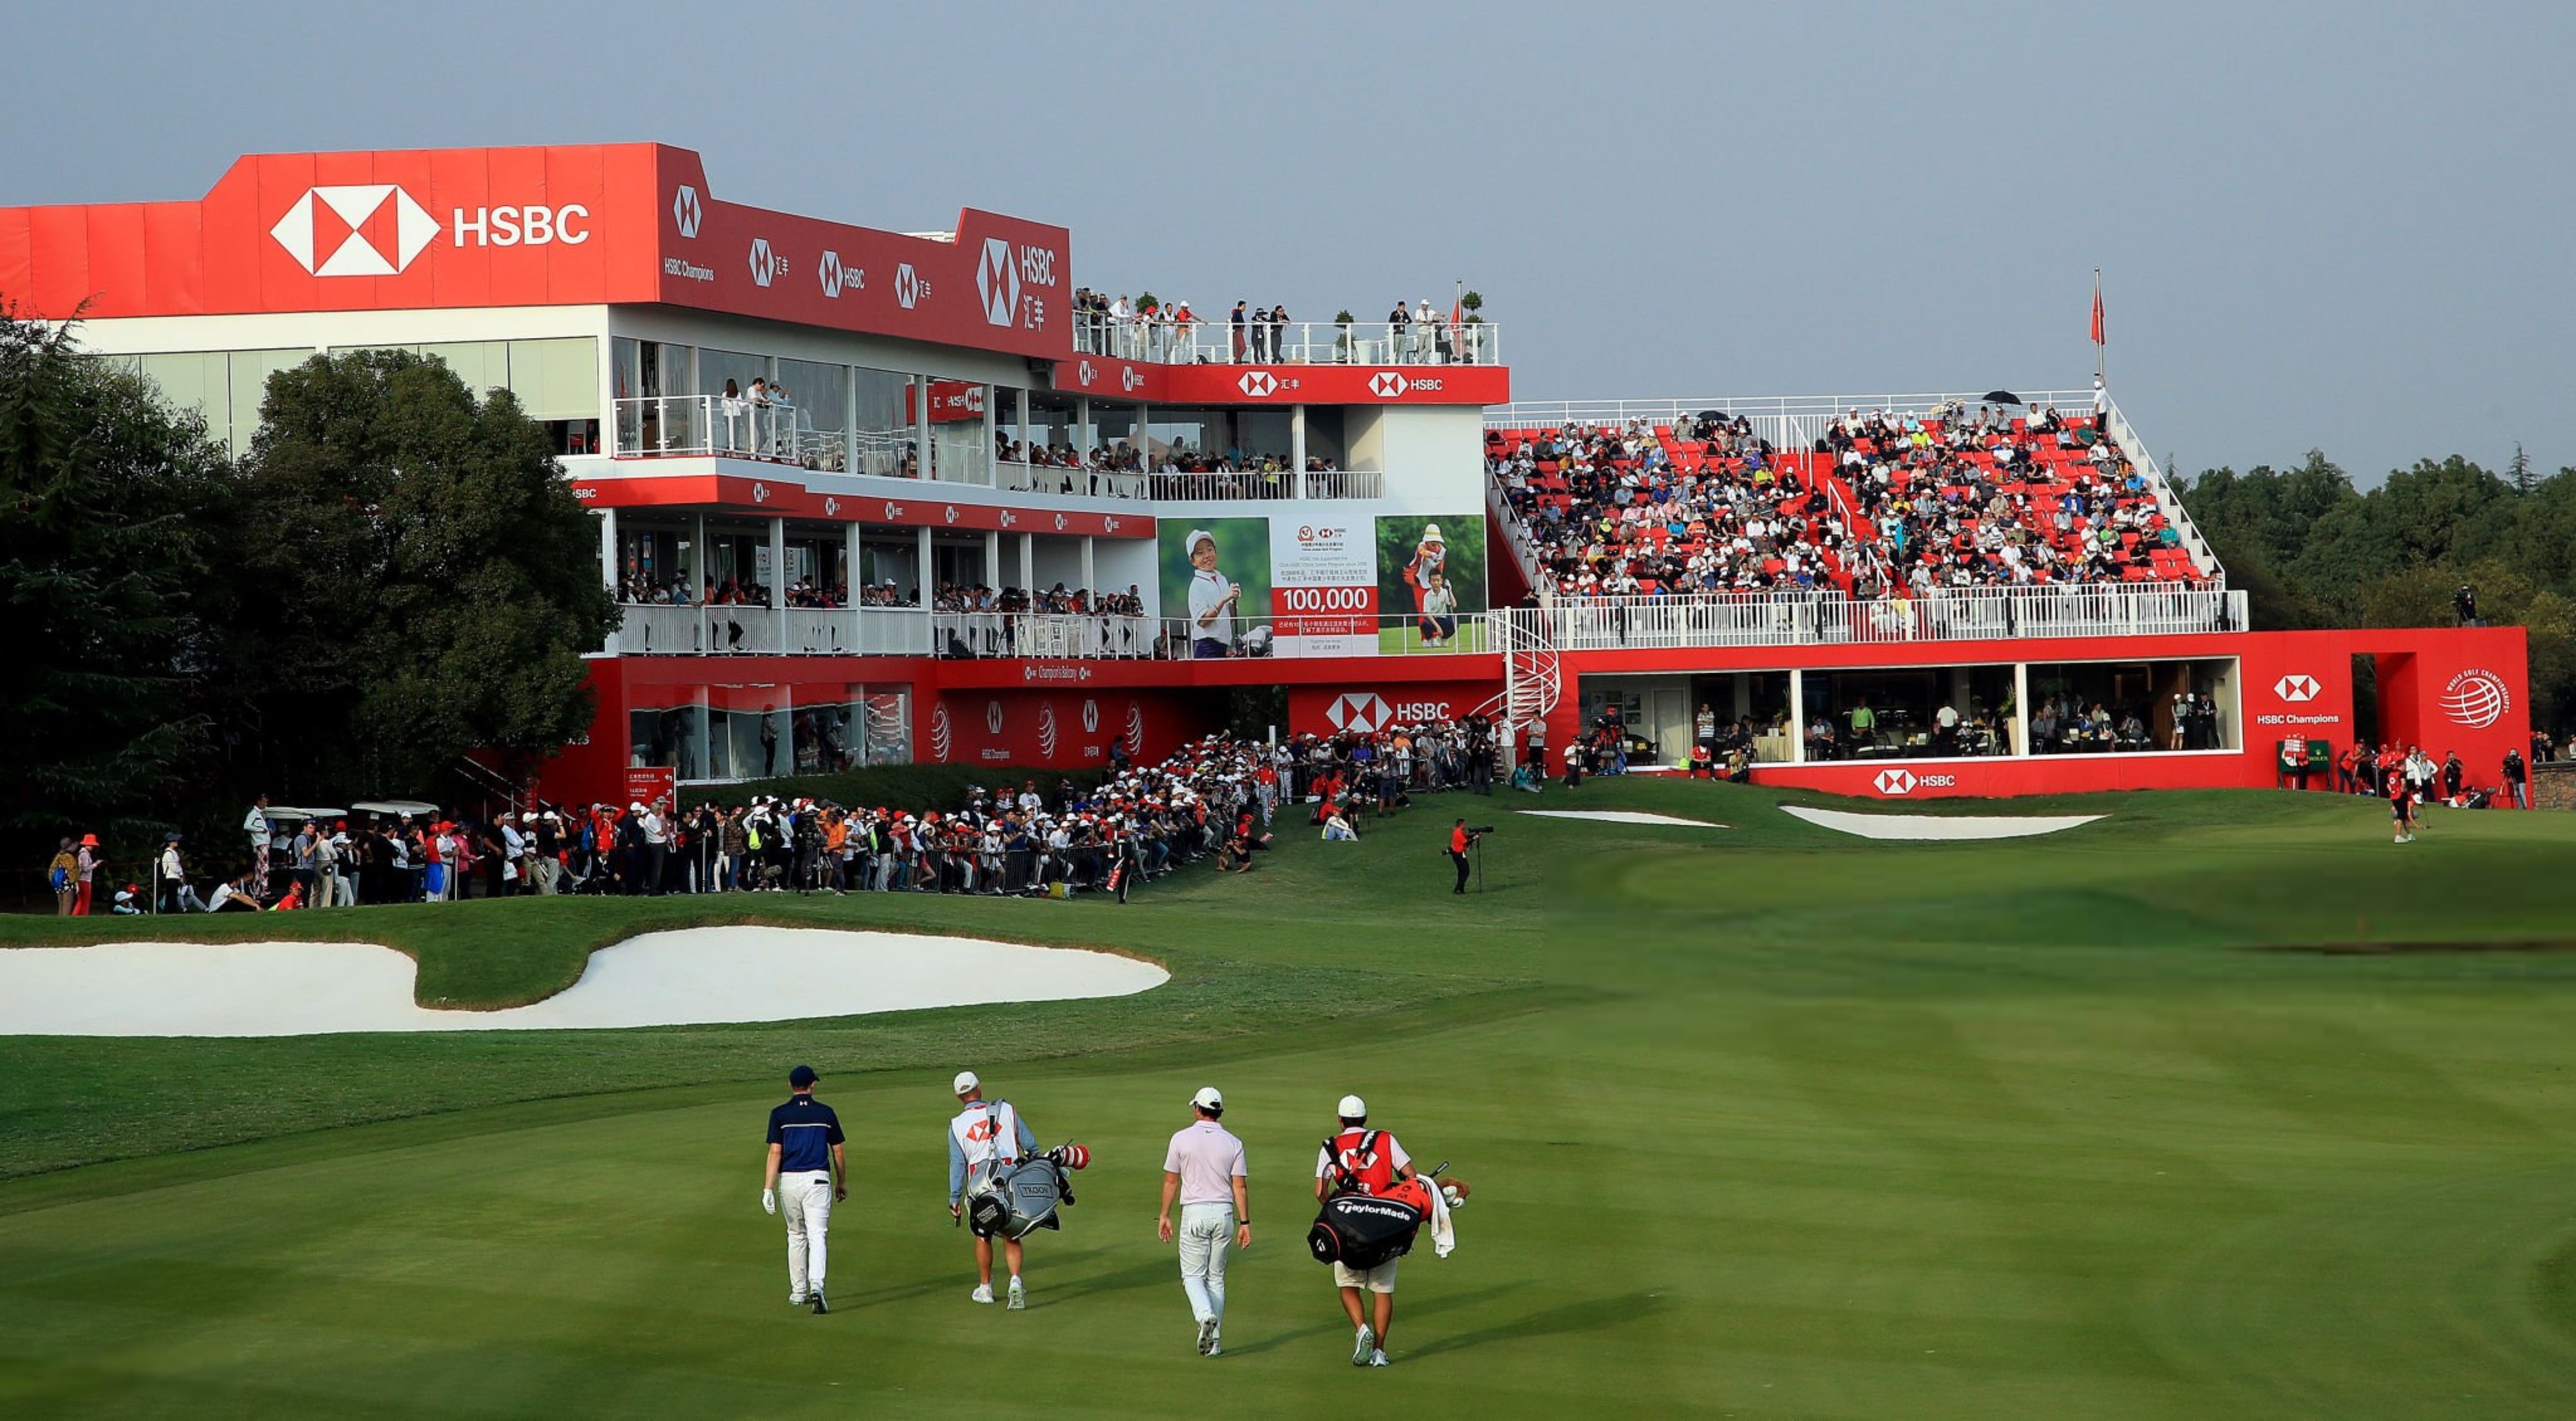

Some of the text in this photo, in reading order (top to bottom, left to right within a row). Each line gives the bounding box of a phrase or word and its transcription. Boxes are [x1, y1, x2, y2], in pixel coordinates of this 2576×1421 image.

[454, 204, 590, 248] HSBC
[665, 257, 714, 282] HSBC Champions
[844, 266, 864, 289] HSBC
[1021, 244, 1055, 288] HSBC
[1023, 293, 1044, 332] 汇丰
[1280, 379, 1300, 390] 汇丰
[1410, 379, 1443, 391] HSBC
[1283, 588, 1368, 613] 100,000
[2446, 674, 2463, 692] WORLD
[2463, 668, 2479, 677] GOLF
[1397, 702, 1450, 721] HSBC
[2257, 714, 2339, 725] HSBC Champions
[1920, 775, 1955, 787] HSBC
[1337, 1201, 1410, 1221] TaylorMade
